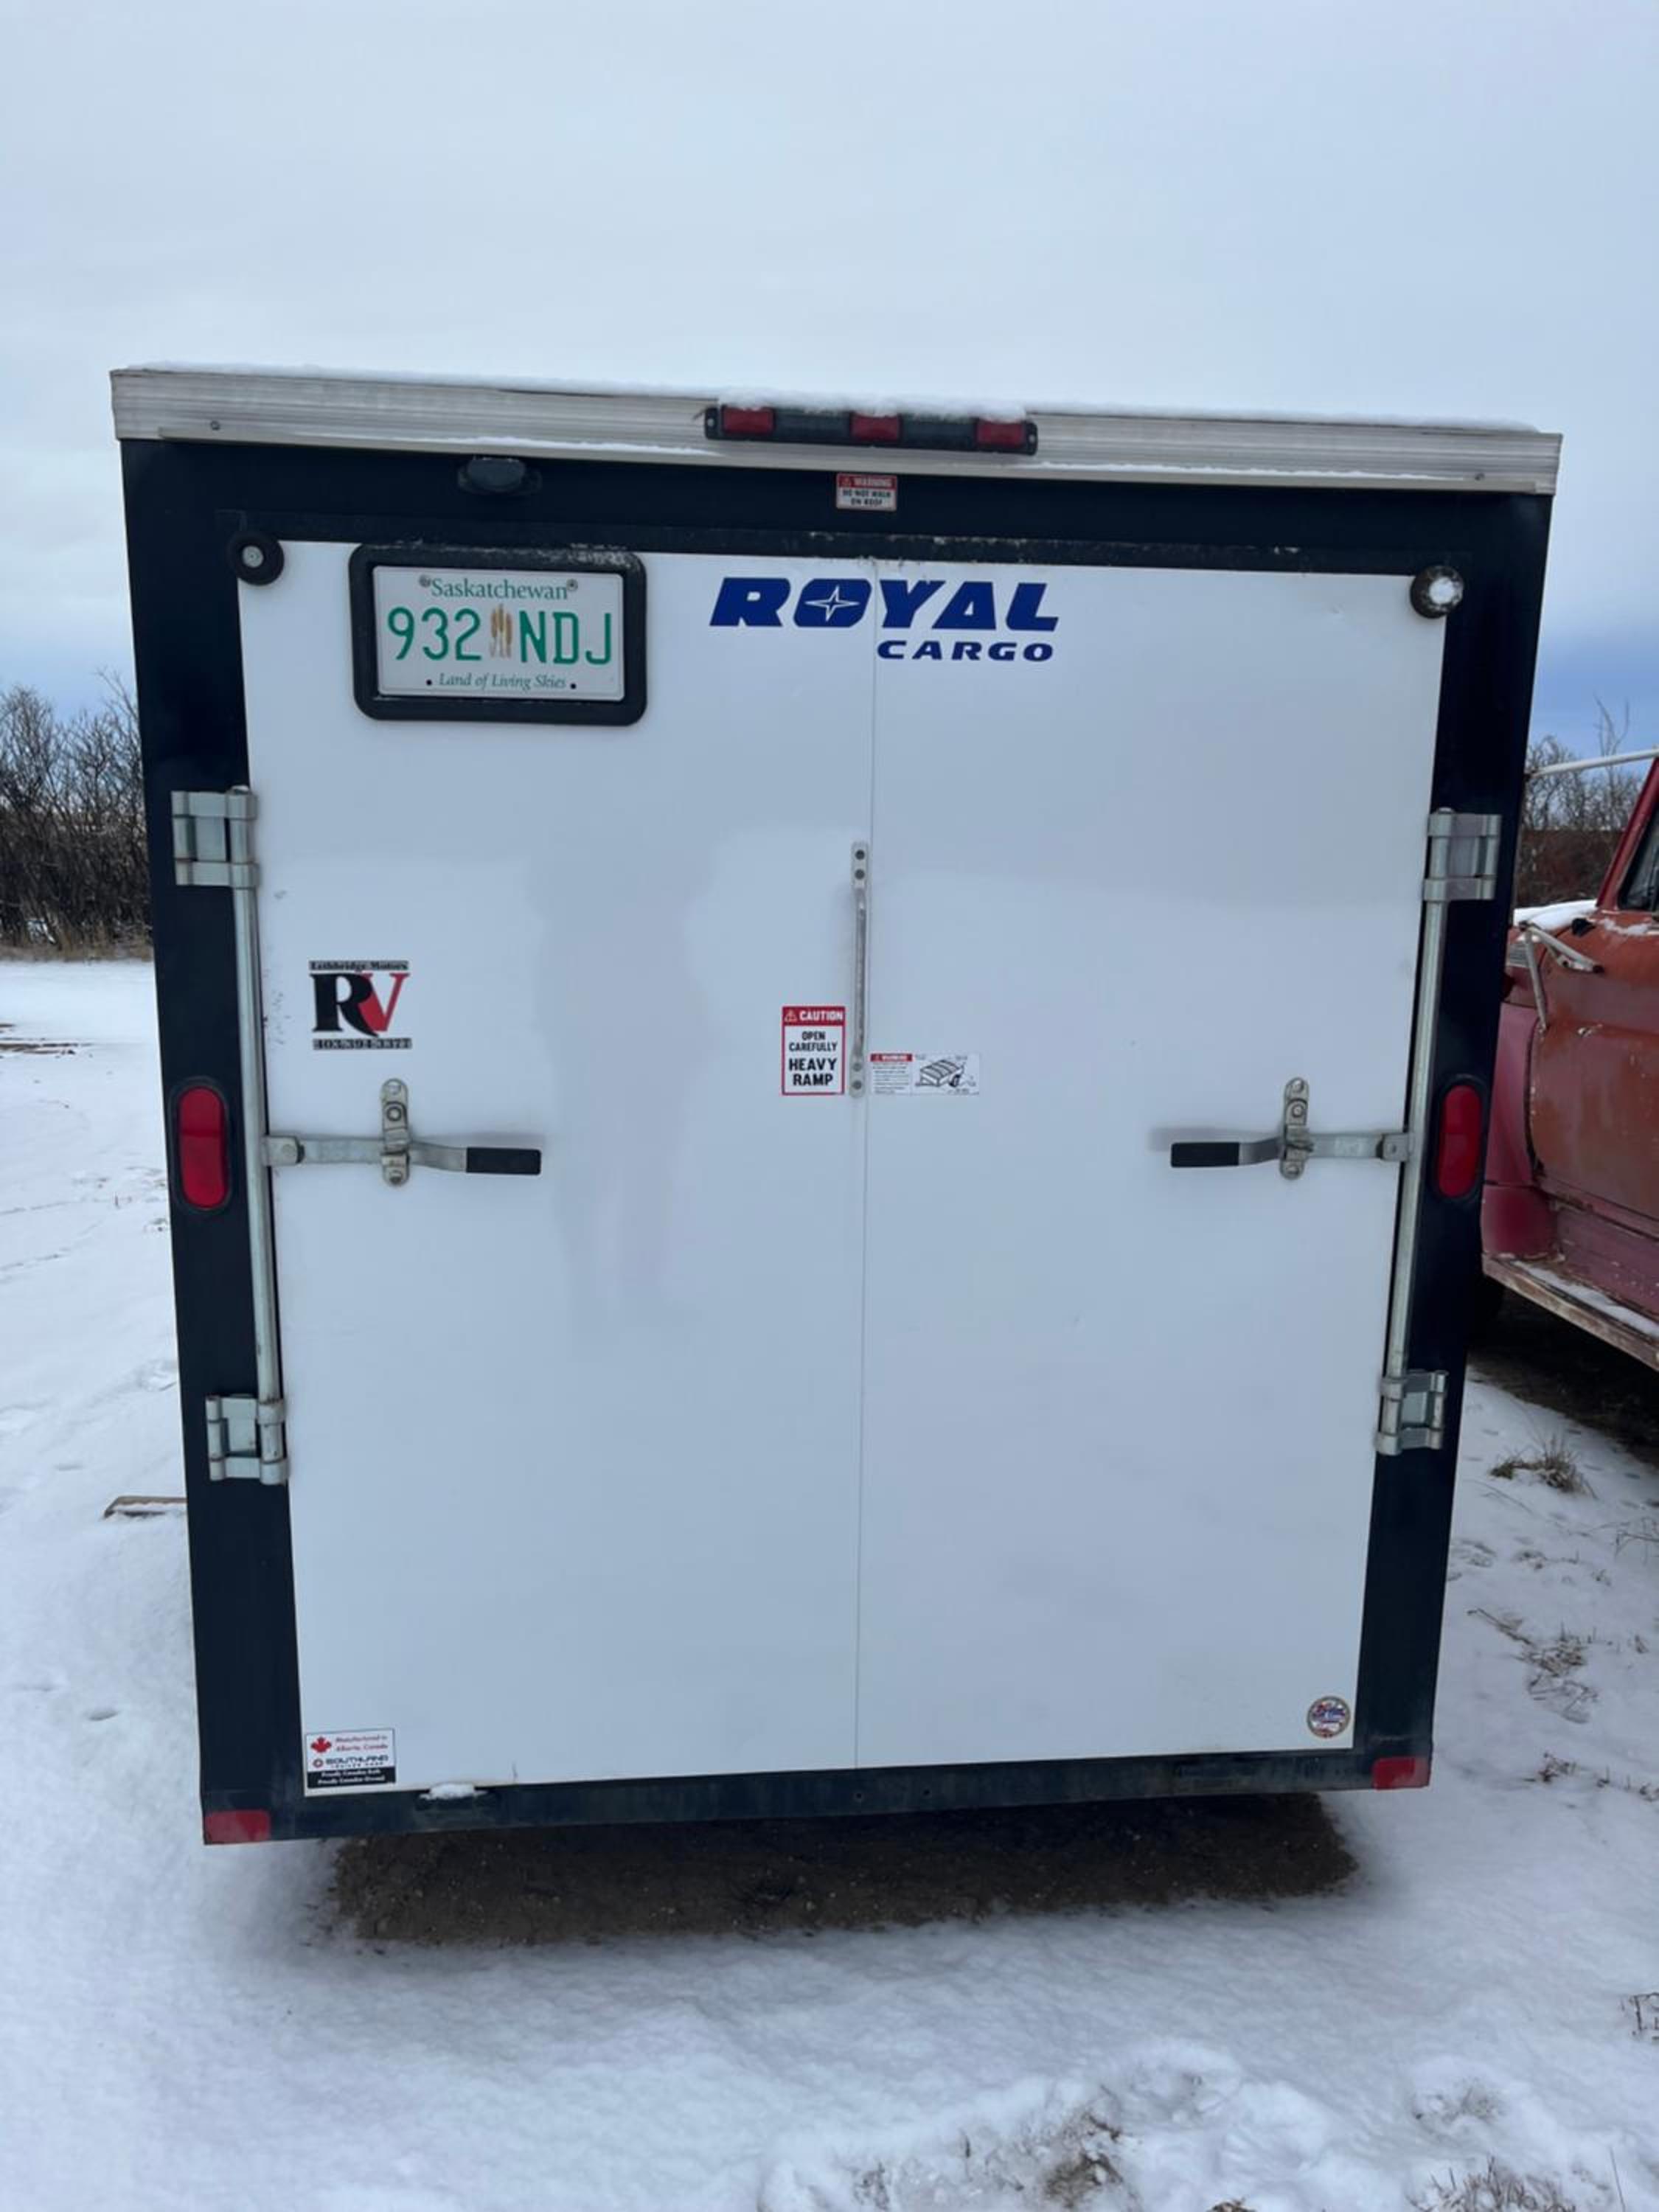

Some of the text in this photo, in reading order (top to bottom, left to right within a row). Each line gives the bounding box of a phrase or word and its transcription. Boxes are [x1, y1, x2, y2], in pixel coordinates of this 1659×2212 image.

[430, 577, 568, 600] Saskatchewan
[709, 577, 1060, 632] ROYAL
[387, 606, 613, 665] 932 NDJ
[877, 640, 1054, 661] CARGO
[439, 672, 566, 692] Land of Living Skies
[309, 973, 411, 1039] RV
[799, 1010, 844, 1022] CAUTION
[801, 1031, 826, 1040] OPEN
[789, 1042, 838, 1051] CAREFULLY
[789, 1058, 837, 1071] HEAVY
[793, 1073, 833, 1086] RAMP
